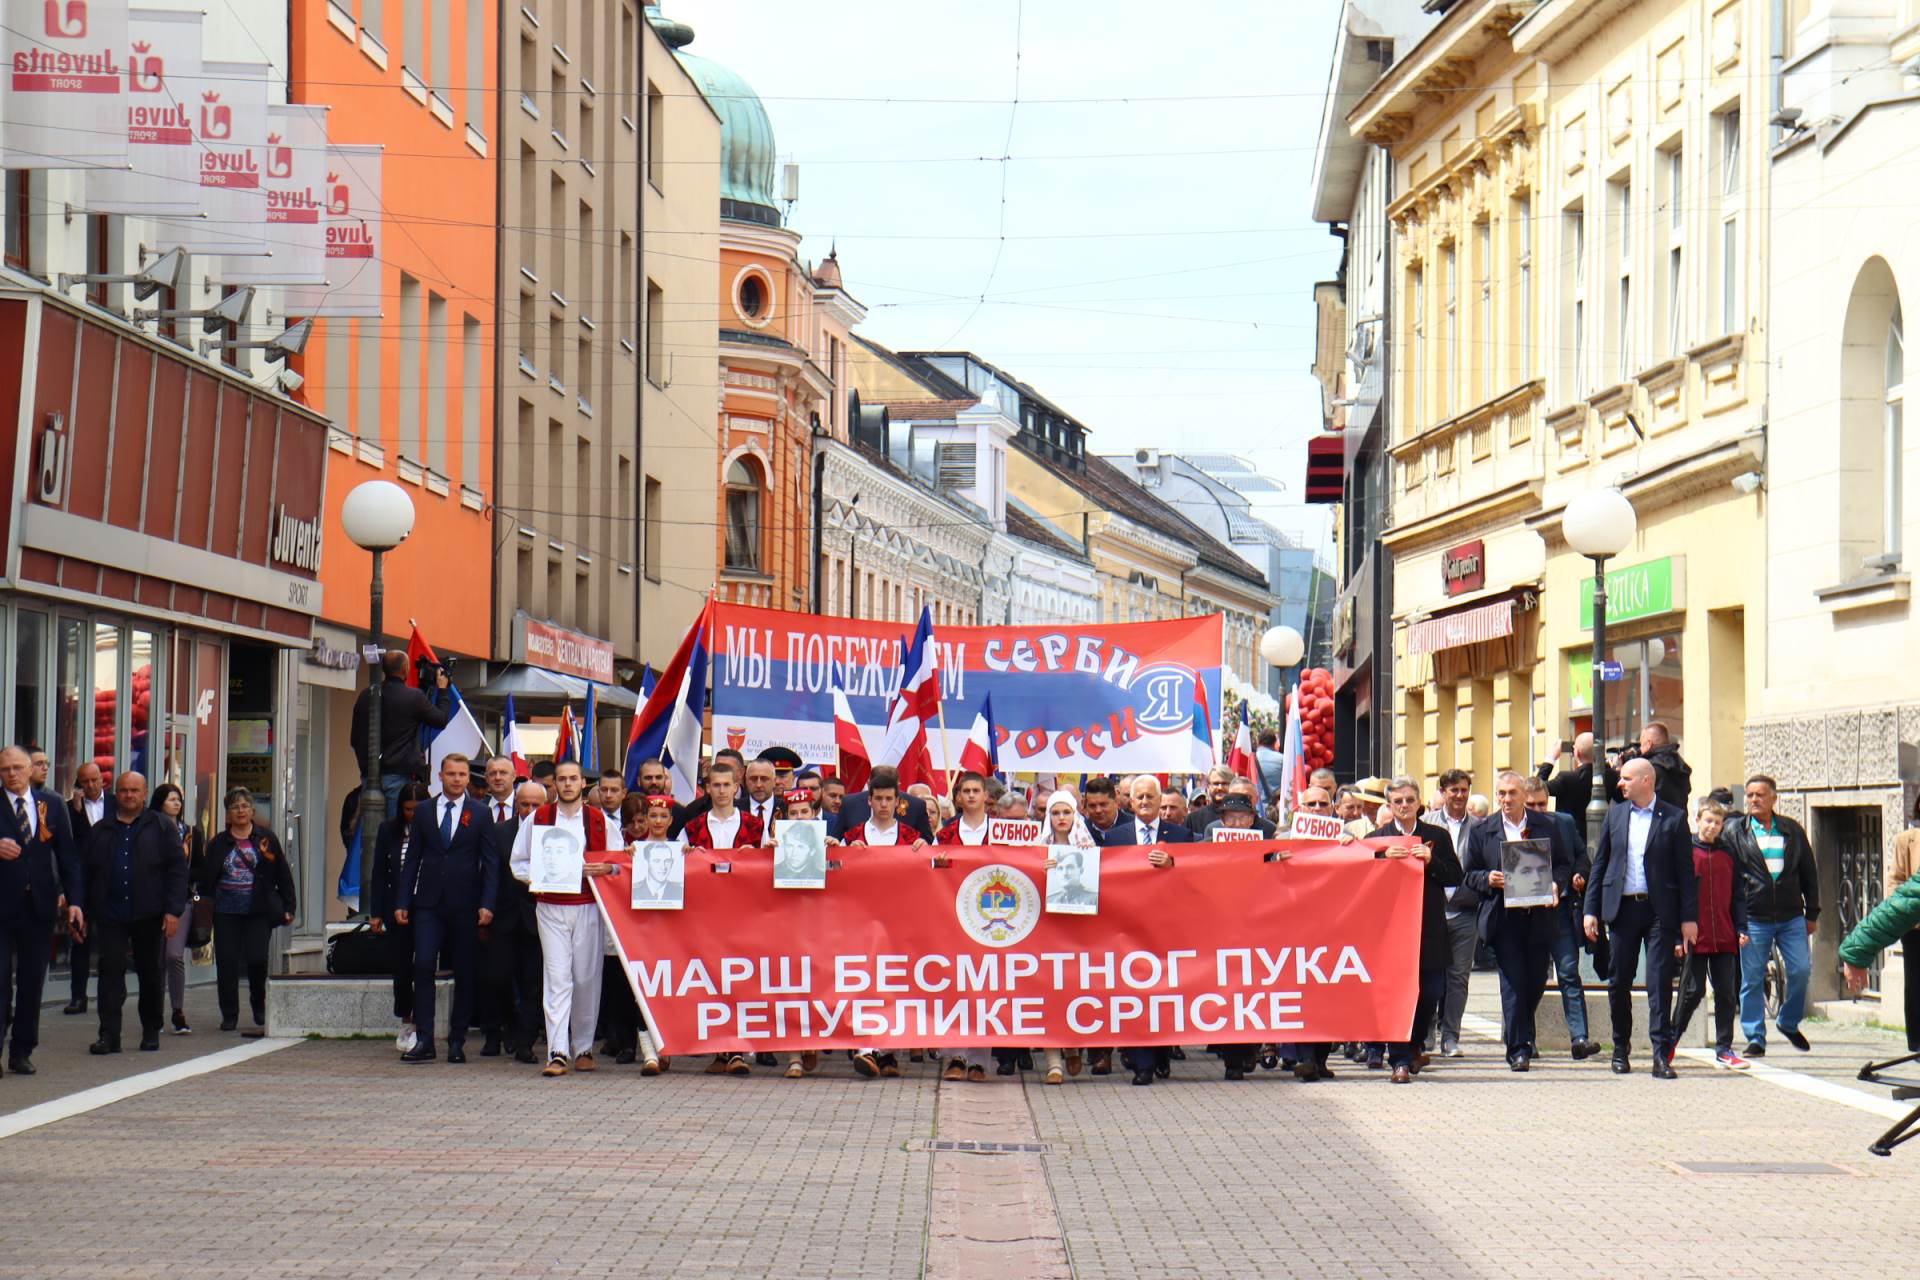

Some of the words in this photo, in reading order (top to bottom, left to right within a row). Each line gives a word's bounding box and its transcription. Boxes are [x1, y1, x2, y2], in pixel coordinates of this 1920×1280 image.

[275, 503, 323, 576] Juventa
[288, 581, 309, 607] SPORT
[724, 625, 773, 690] МЫ
[785, 631, 966, 712] ПОБЕЖДМ
[992, 822, 1038, 842] СУБНОР
[1295, 816, 1341, 839] СУБНОР
[630, 956, 811, 997] МАРШ
[835, 949, 1196, 992] БЕСМРТНОГ
[1216, 946, 1371, 986] ПУКА
[697, 997, 1045, 1040] РЕПУБЛИКЕ
[1066, 991, 1304, 1034] СРПСКЕ
